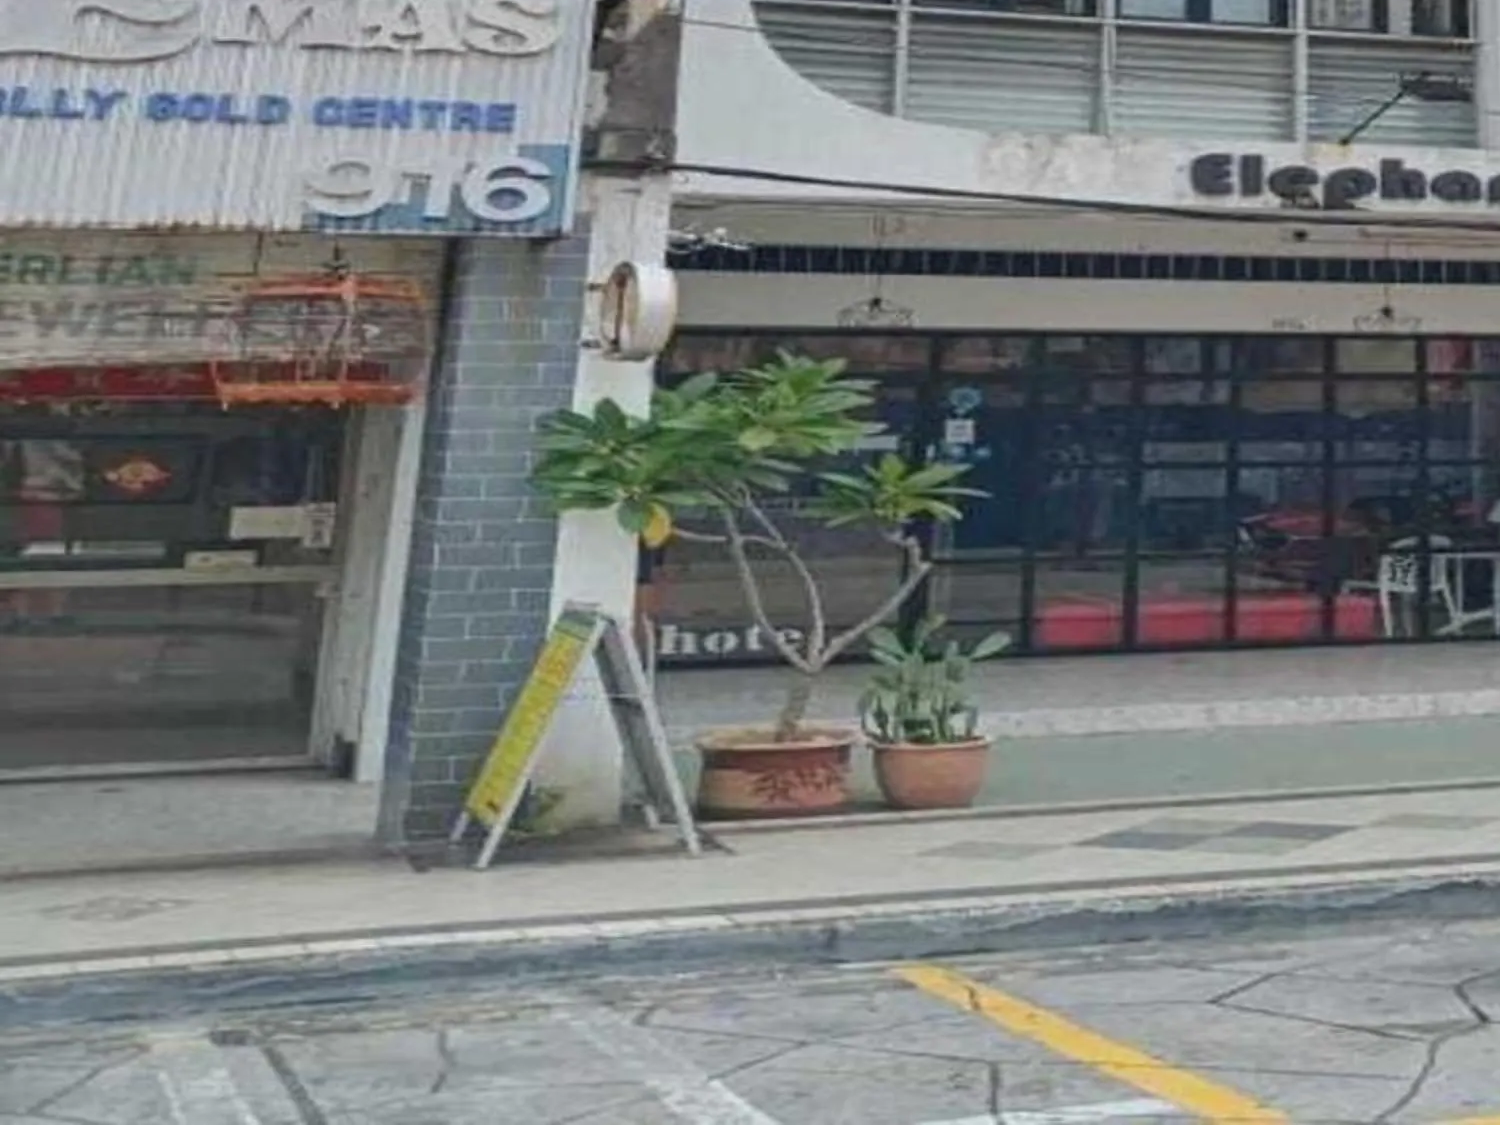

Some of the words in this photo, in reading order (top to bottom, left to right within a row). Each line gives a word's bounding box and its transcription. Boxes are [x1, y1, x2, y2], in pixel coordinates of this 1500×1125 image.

[0, 86, 128, 121] LLY
[146, 91, 289, 125] GOLD
[312, 96, 517, 132] CENTRE
[303, 155, 553, 222] 916
